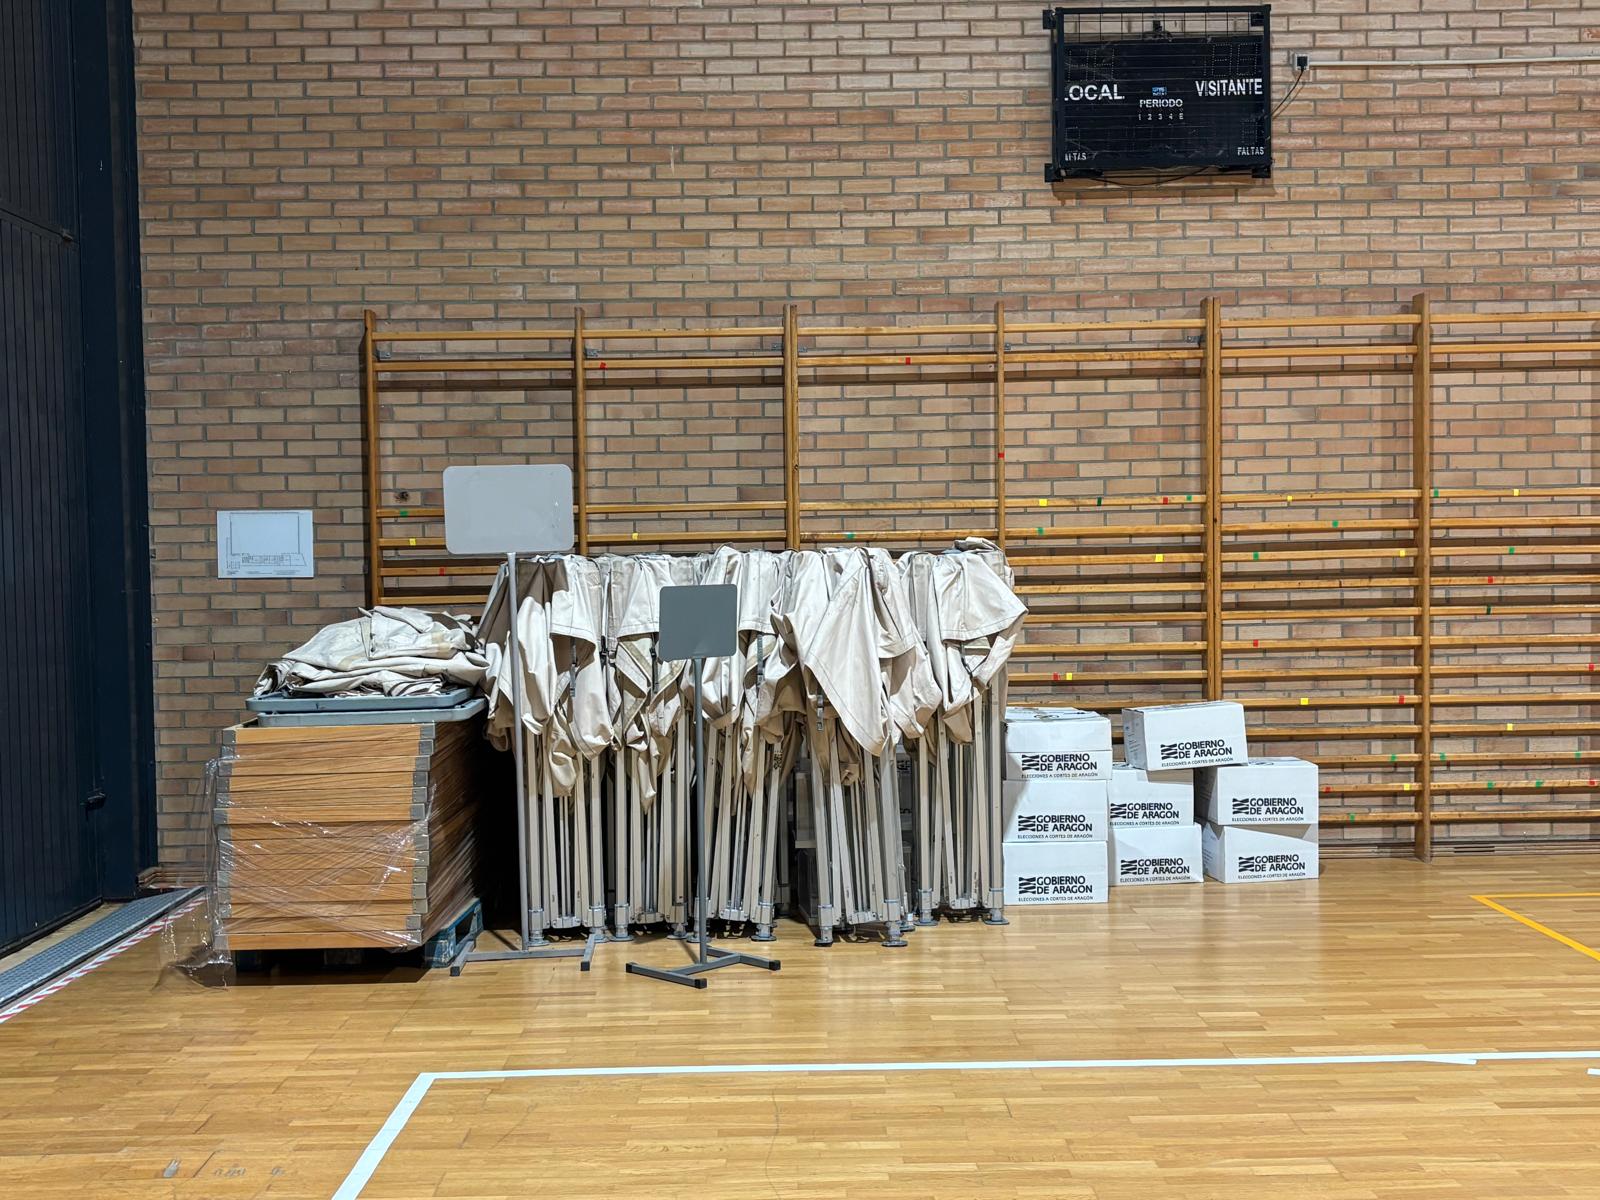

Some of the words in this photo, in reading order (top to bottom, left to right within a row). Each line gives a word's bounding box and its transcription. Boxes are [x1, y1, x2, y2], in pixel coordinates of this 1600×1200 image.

[1064, 84, 1125, 100] OCAL
[1195, 79, 1263, 96] VISITANTE
[1140, 99, 1183, 108] PERIODO
[1237, 147, 1264, 155] FALTAS
[1178, 740, 1224, 750] GOBIERNO
[1194, 747, 1232, 757] ARAGON
[1040, 753, 1090, 762] GOBIERNO
[1056, 762, 1097, 770] ARAGON
[1250, 798, 1297, 806] GOBIERNO
[1037, 815, 1085, 823] GOBIERNO
[1142, 811, 1179, 819] ARAGON
[1138, 858, 1183, 866] GOBIERNO
[1255, 854, 1299, 863] GOBIERNO
[1152, 866, 1190, 874] ARAGON
[1269, 862, 1305, 871] ARAGON
[1037, 876, 1085, 885] GOBIERNO
[1053, 885, 1092, 894] ARAGON
